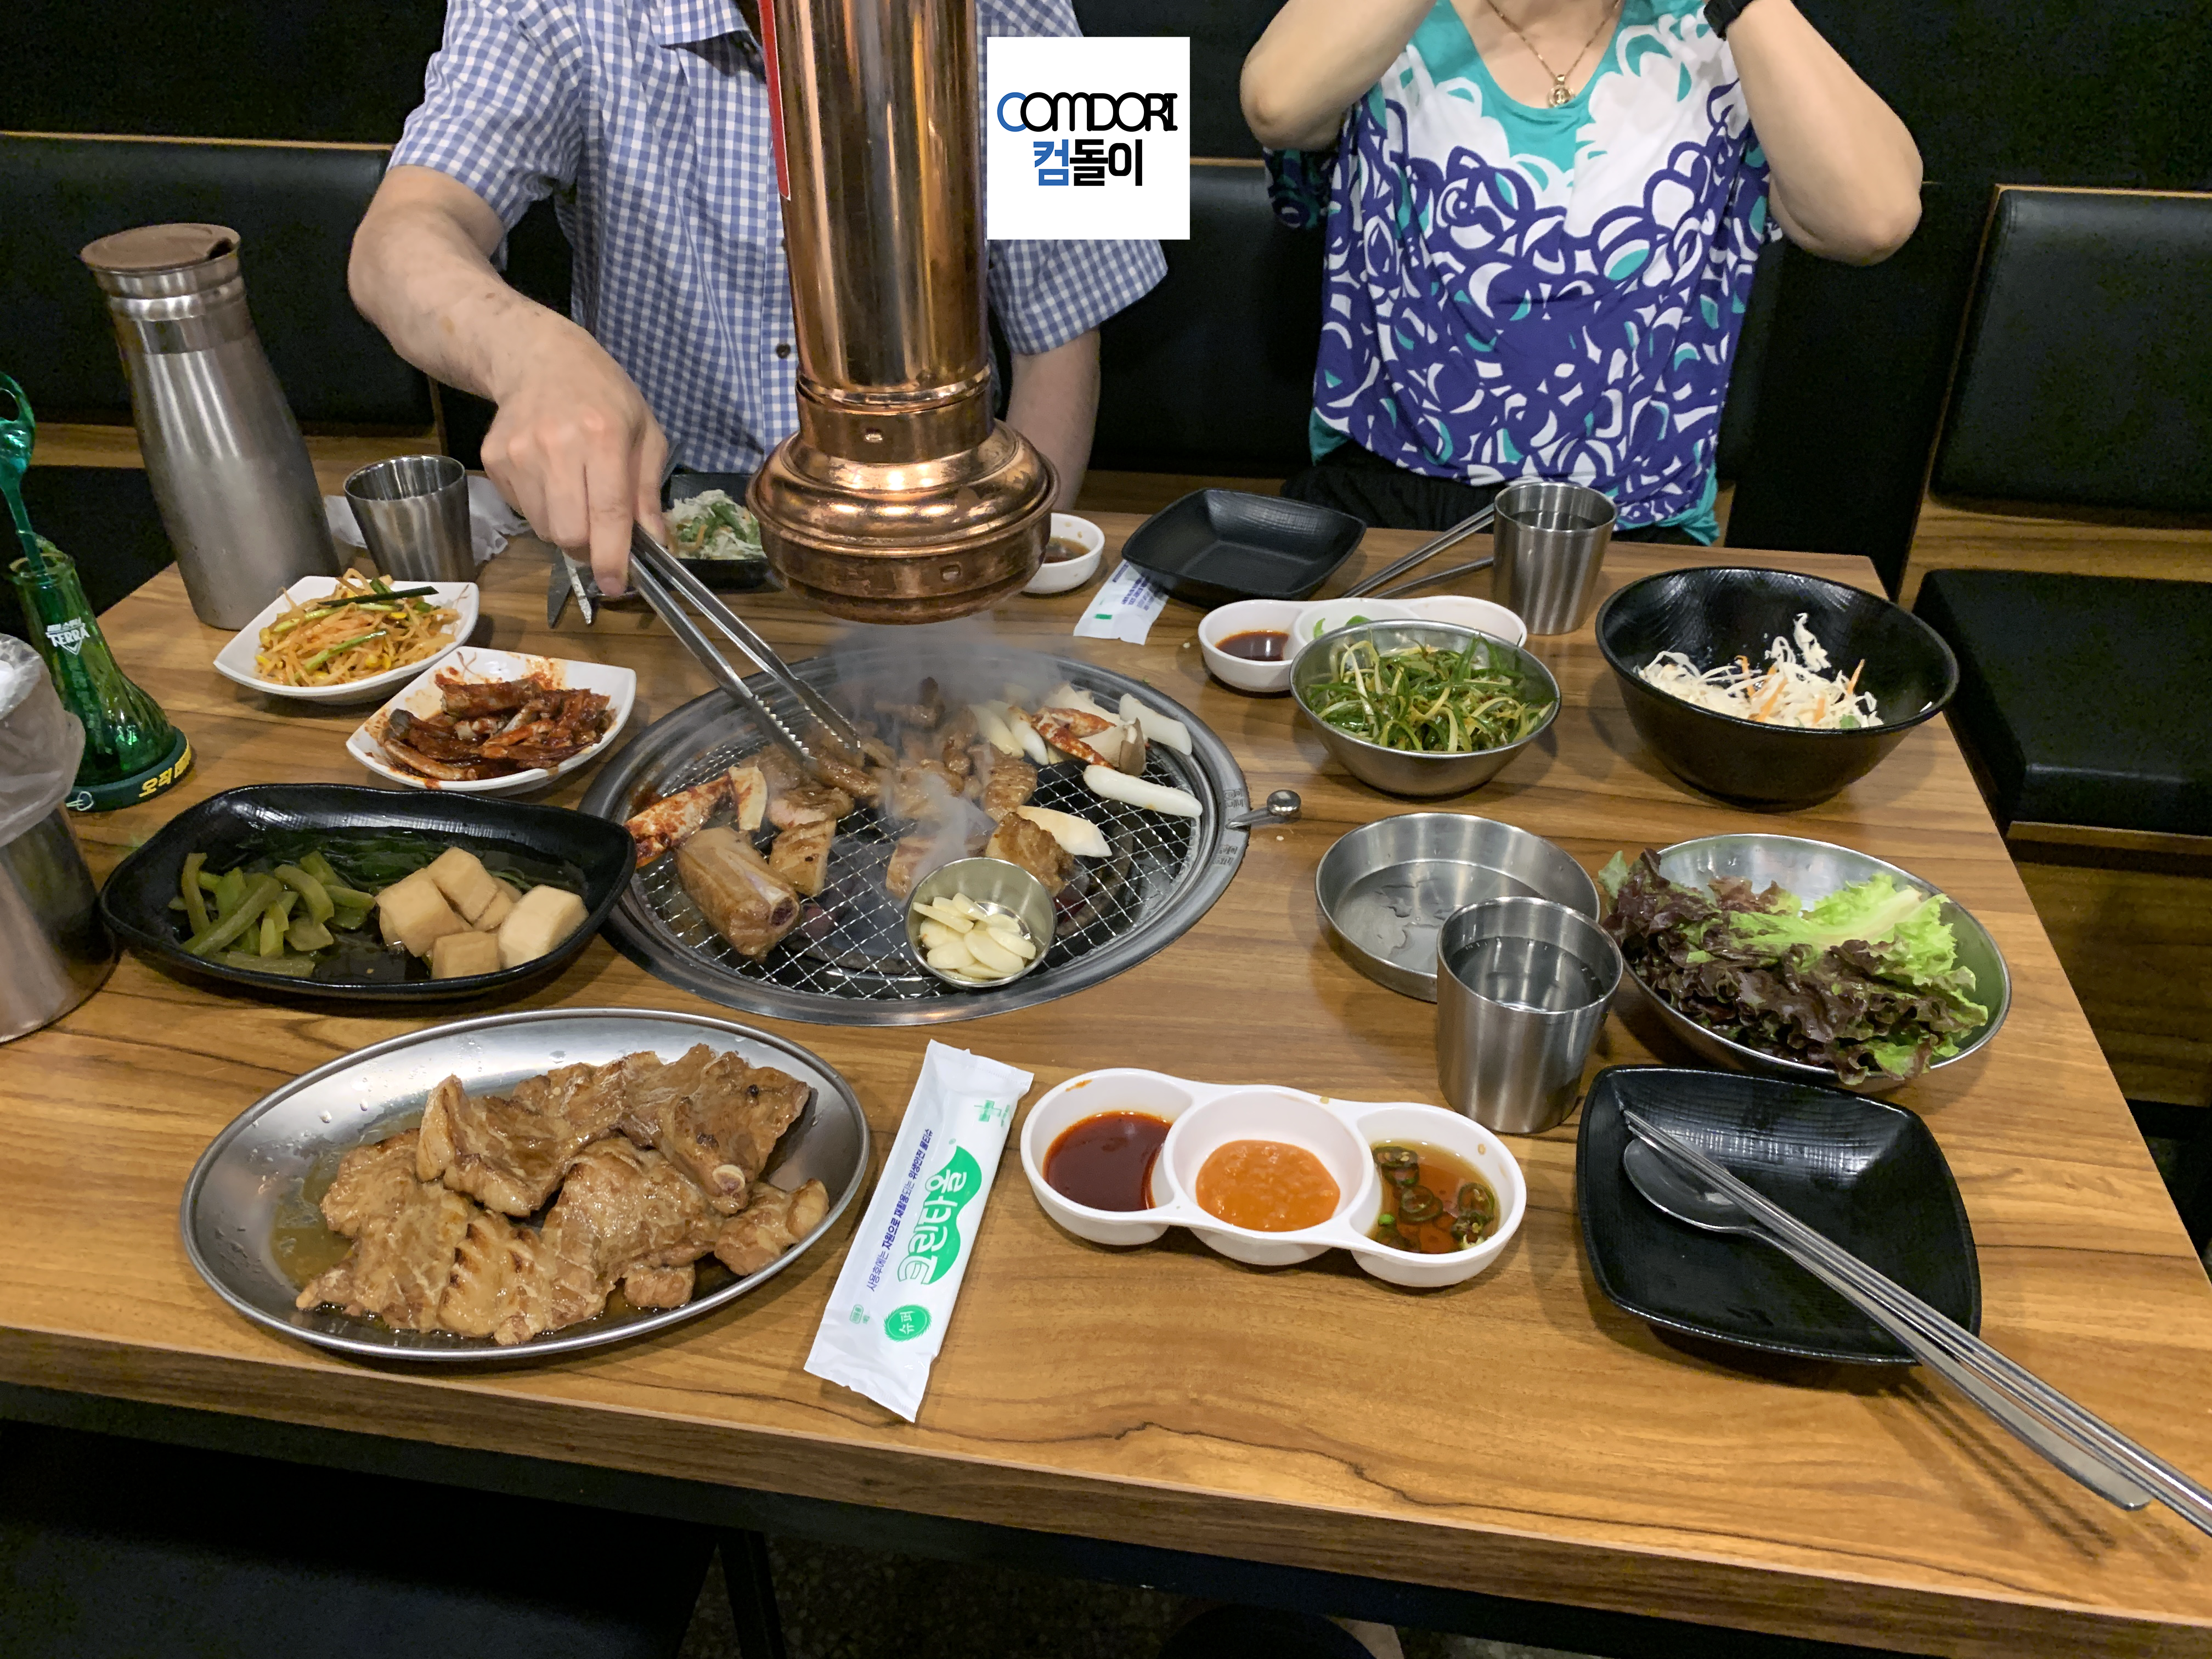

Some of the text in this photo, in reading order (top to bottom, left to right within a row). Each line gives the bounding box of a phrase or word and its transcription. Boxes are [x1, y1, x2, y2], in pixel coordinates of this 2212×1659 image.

[46, 627, 91, 647] TERRA
[139, 768, 172, 797] 오직
[866, 1127, 934, 1291] 사용후에는 자원으로 재활용되는 위생안전 물티슈
[898, 1169, 967, 1284] 크린타올
[899, 1311, 916, 1335] 슈퍼
